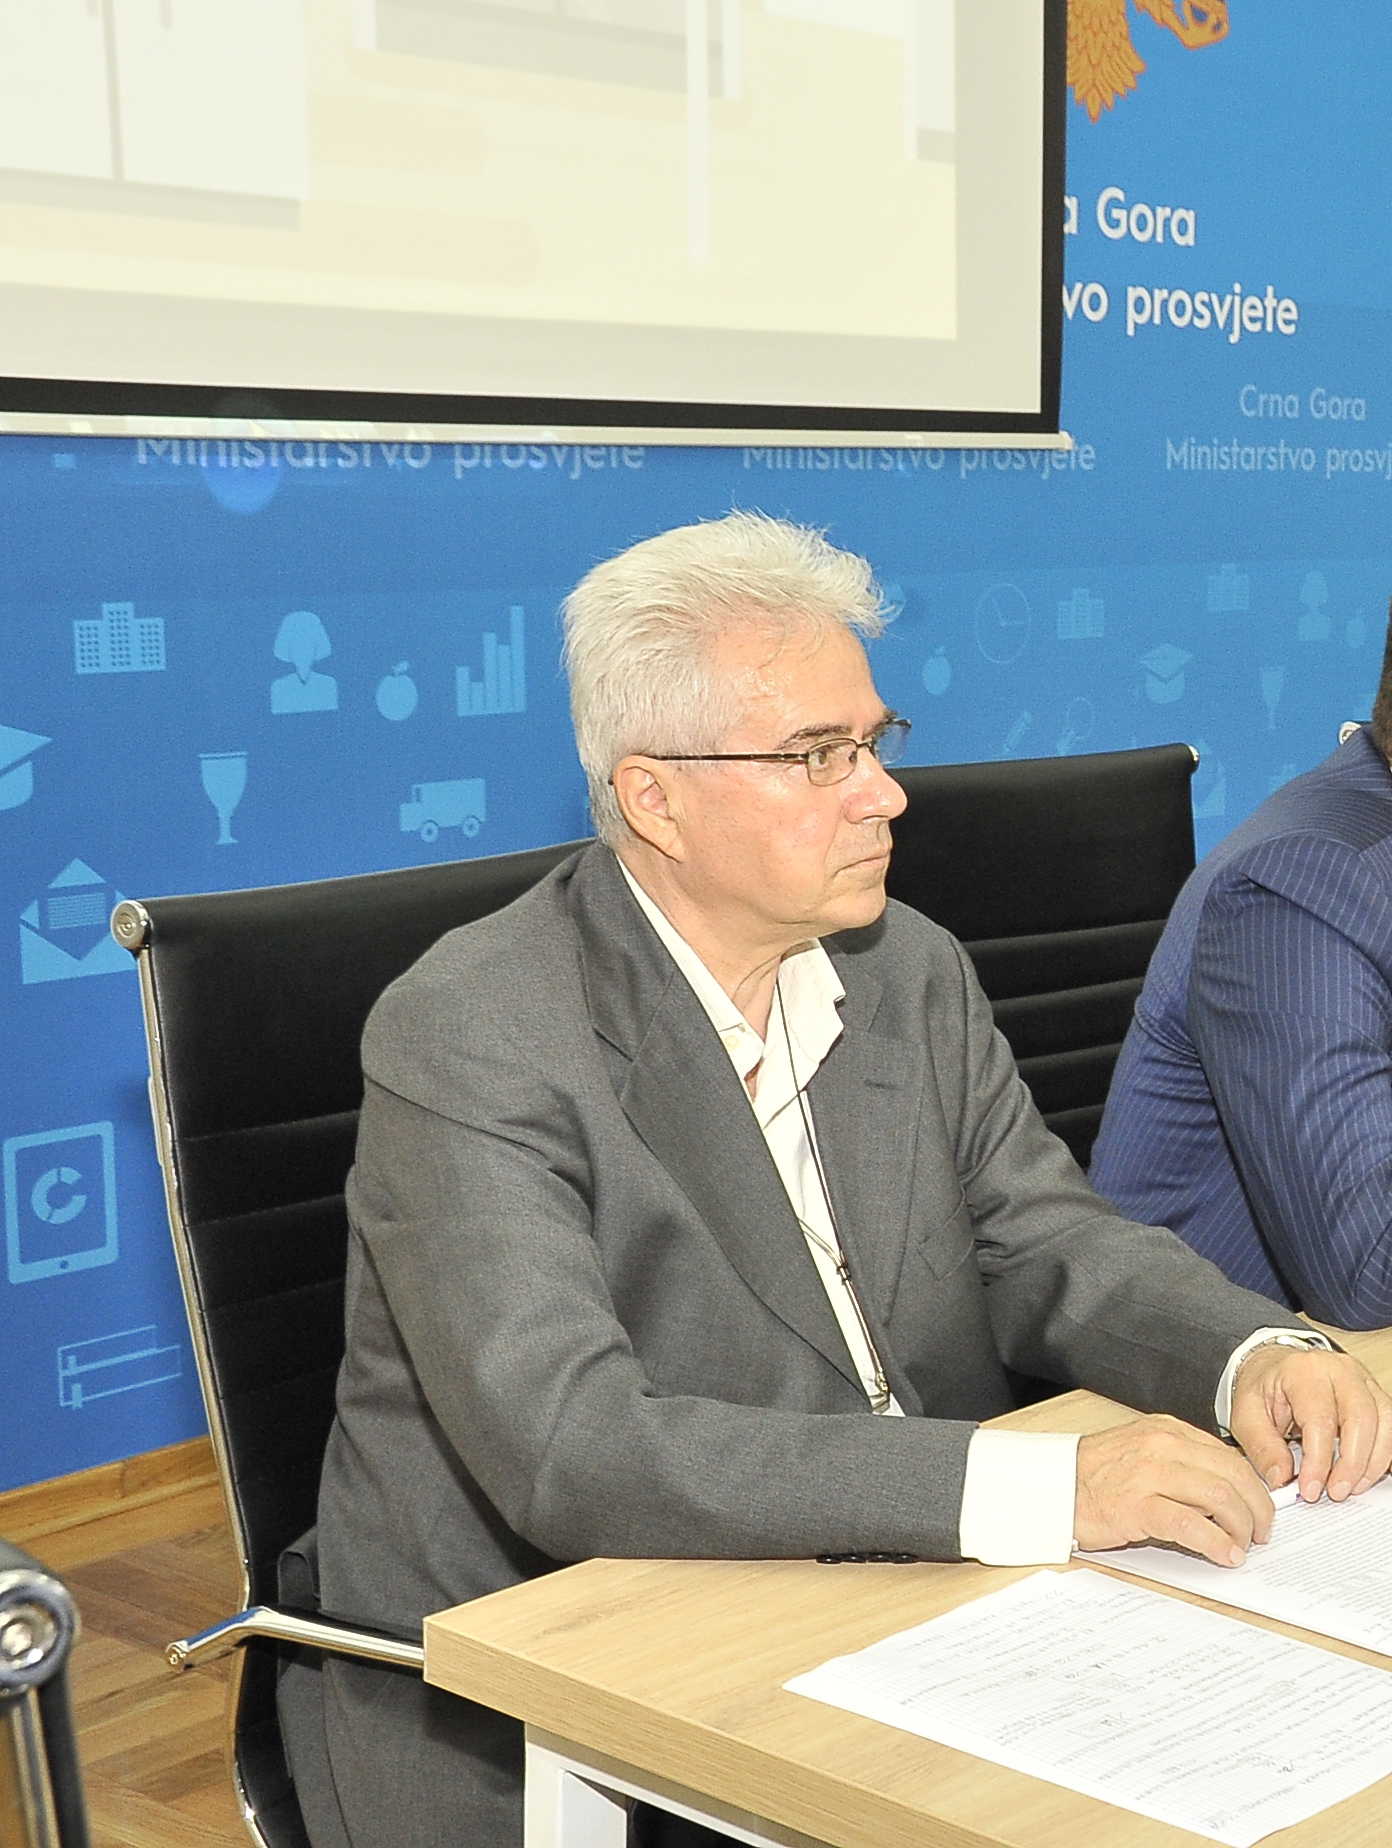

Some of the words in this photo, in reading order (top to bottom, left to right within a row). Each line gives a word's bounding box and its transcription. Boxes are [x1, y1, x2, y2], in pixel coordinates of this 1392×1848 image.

[1096, 186, 1196, 247] Gora
[1126, 282, 1299, 344] prosvjete
[1240, 384, 1299, 418] Crna
[1309, 387, 1367, 421] Gora
[1165, 437, 1316, 471] Ministarstvo
